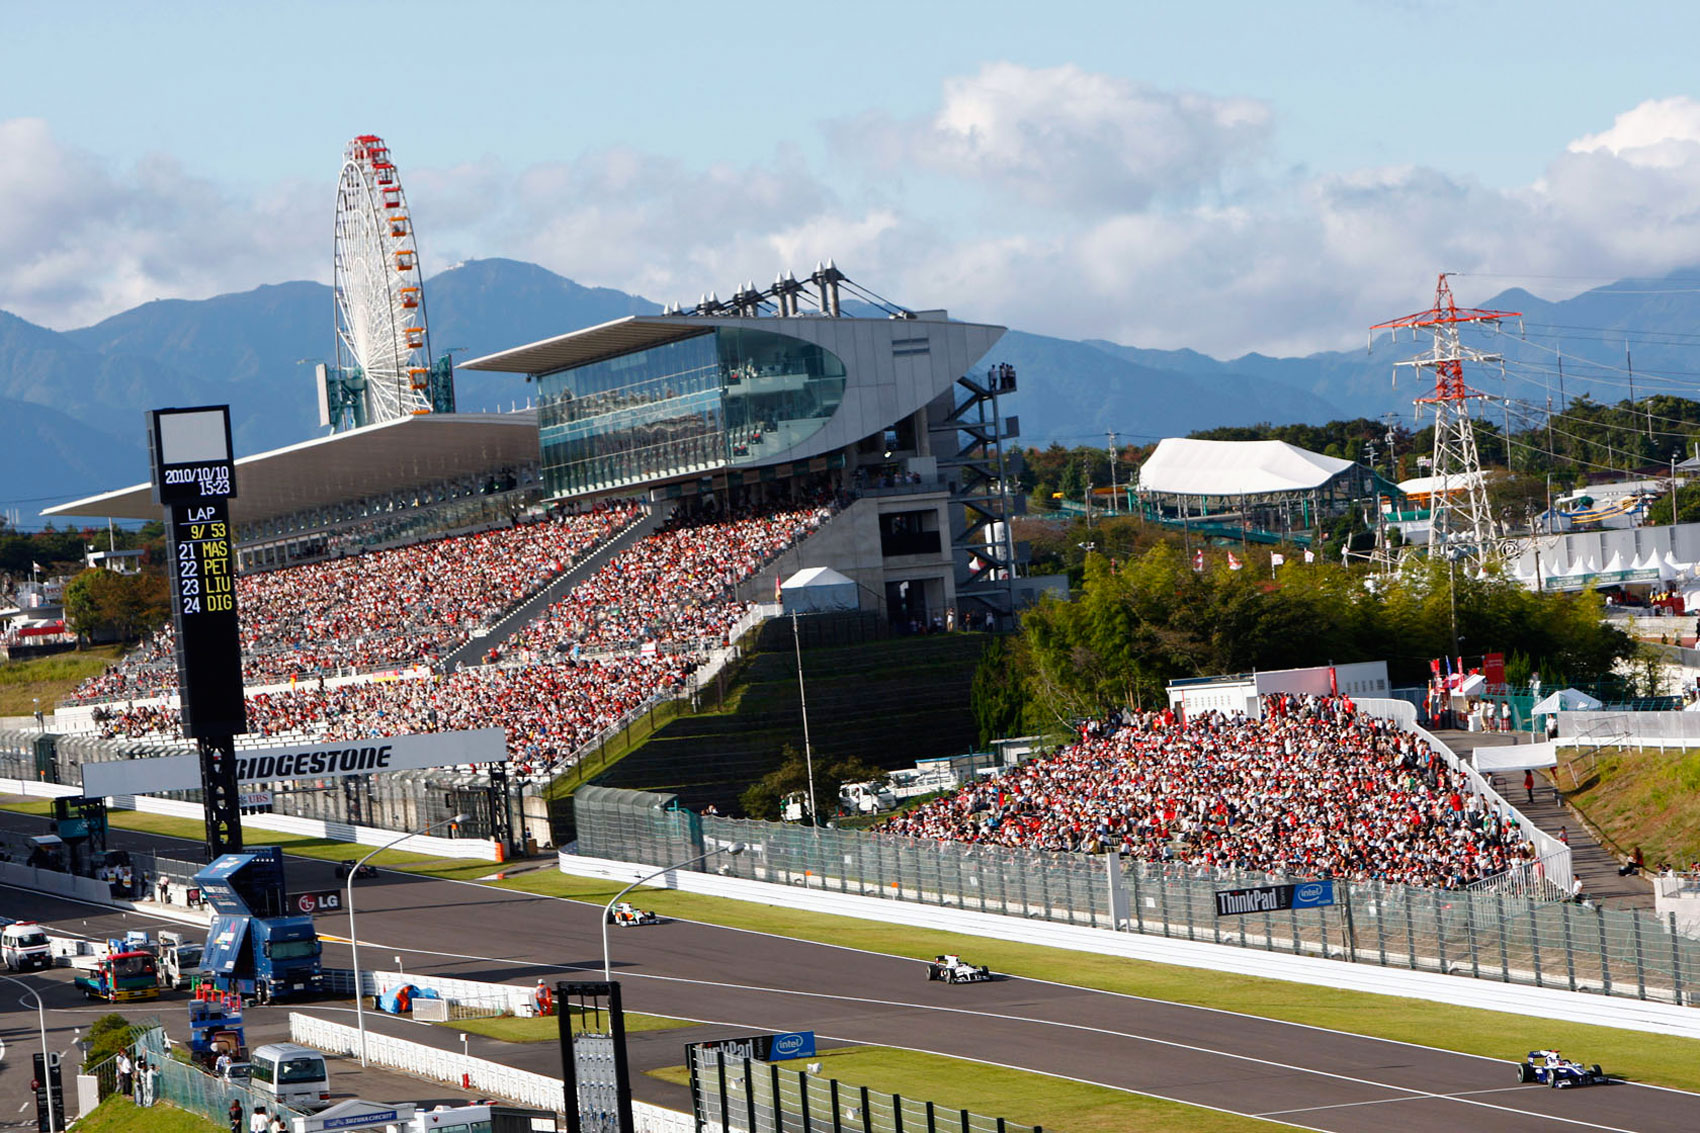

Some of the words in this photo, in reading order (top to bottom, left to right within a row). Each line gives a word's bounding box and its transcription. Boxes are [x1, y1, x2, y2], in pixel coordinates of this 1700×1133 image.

[165, 466, 229, 484] 2010/10/10
[200, 480, 230, 496] 15:23
[188, 507, 215, 521] LAP
[191, 524, 205, 539] 9/
[211, 523, 226, 538] 53
[179, 543, 196, 560] 21
[202, 541, 227, 558] MAS
[180, 561, 198, 578] 22
[204, 558, 228, 575] PET
[182, 579, 199, 595] 23
[205, 576, 231, 593] LIU
[184, 597, 201, 614] 24
[207, 595, 232, 612] DIG
[236, 746, 392, 780] RIDGESTONE
[248, 794, 269, 803] UBS
[319, 895, 338, 908] LG
[1218, 888, 1278, 914] ThinkPad
[49, 1052, 60, 1067] D
